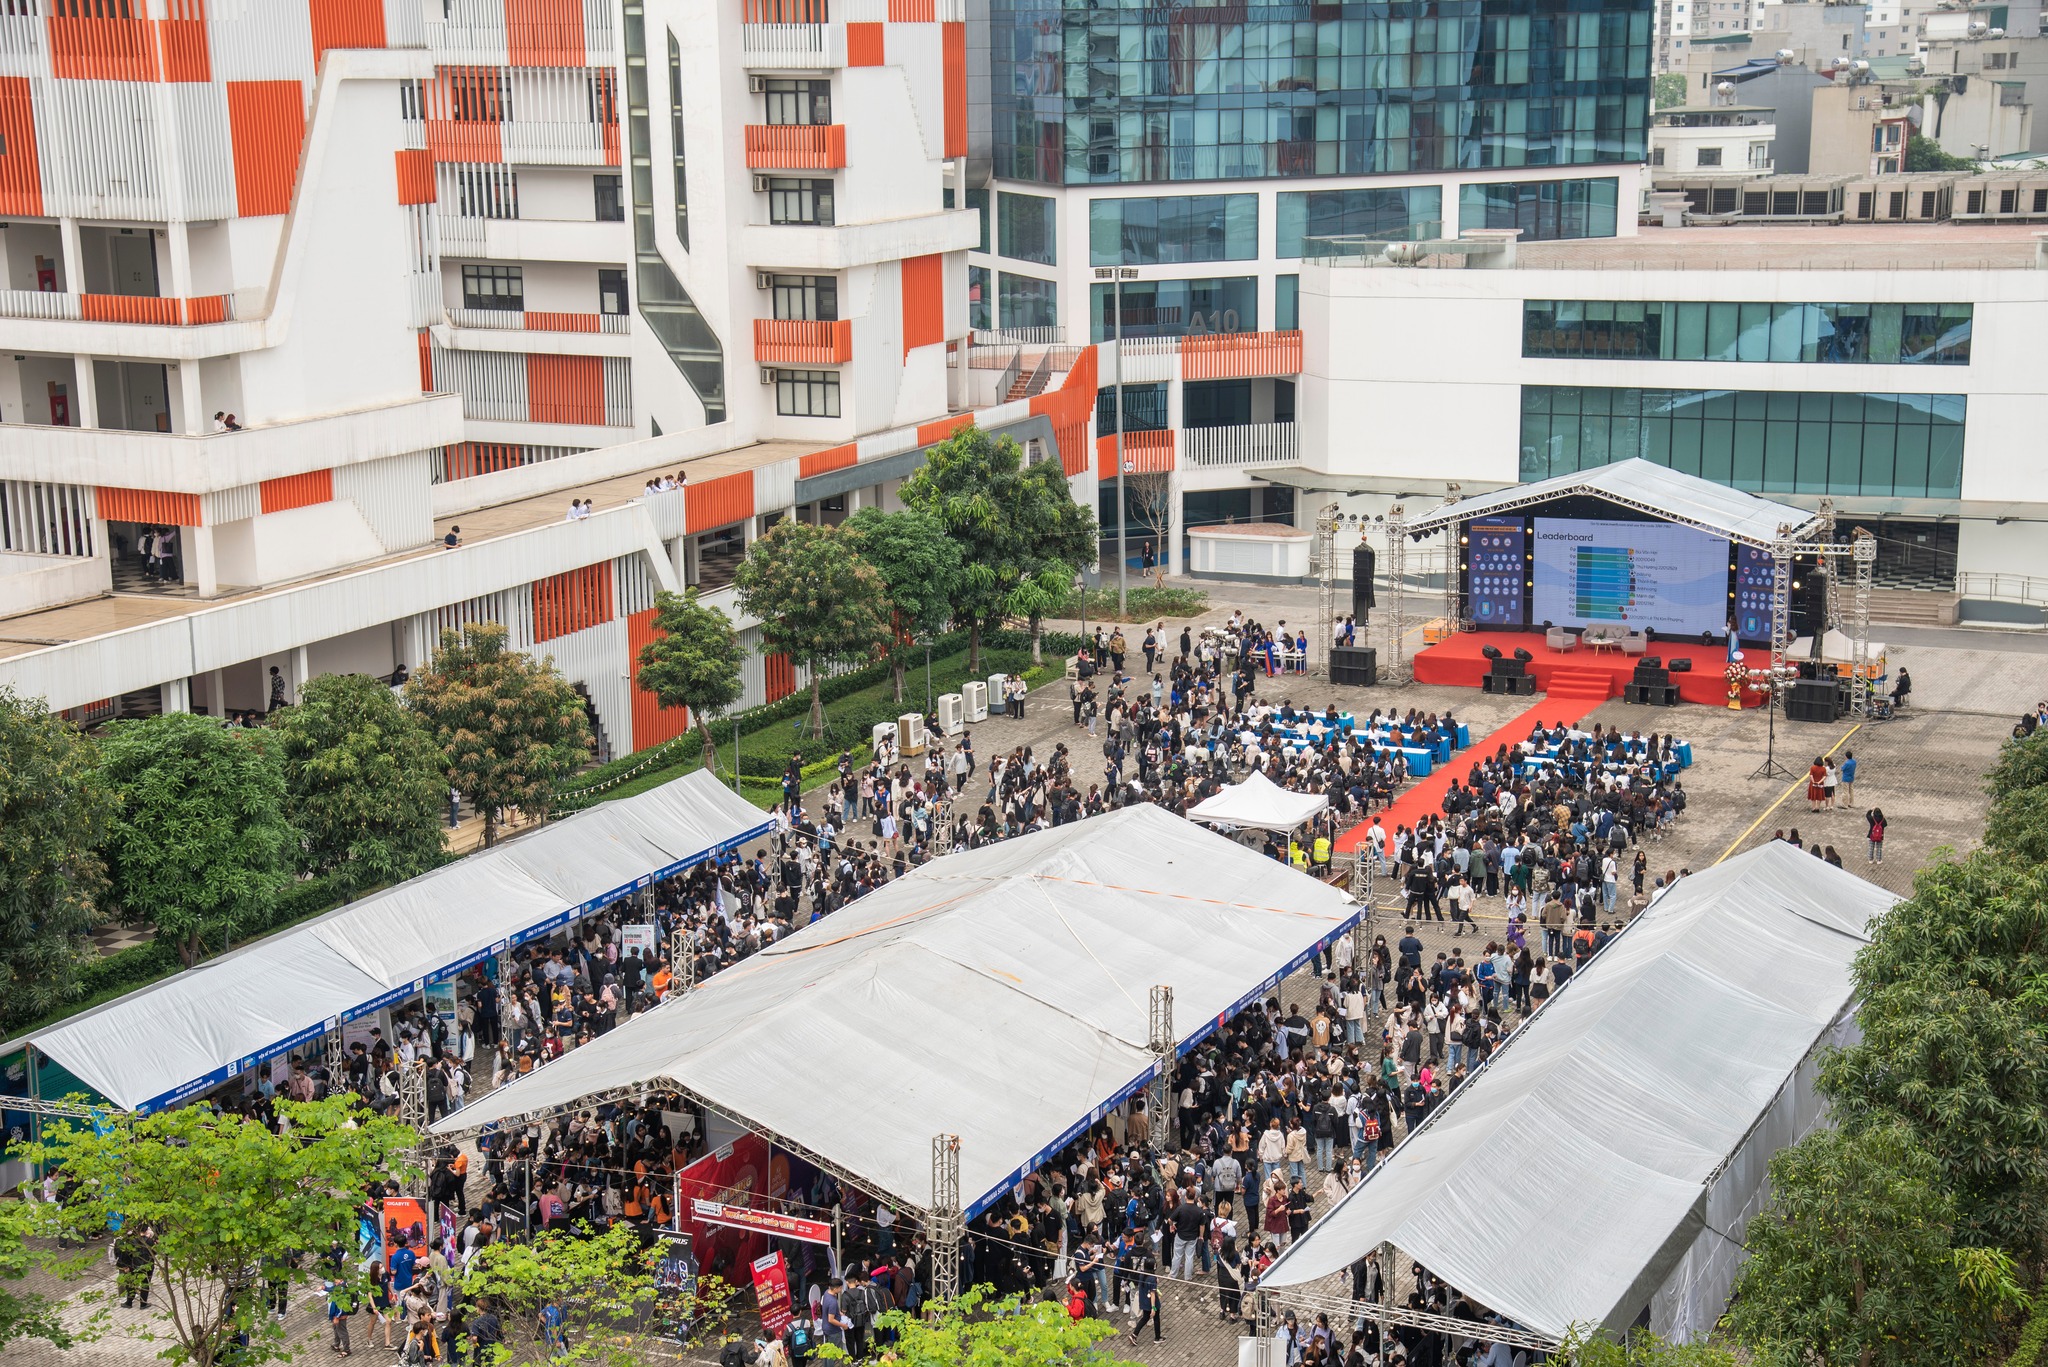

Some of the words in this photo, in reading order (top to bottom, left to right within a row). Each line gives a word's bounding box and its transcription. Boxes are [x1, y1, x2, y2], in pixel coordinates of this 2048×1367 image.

[1187, 309, 1239, 336] A10
[1537, 531, 1593, 541] Leaderboard
[997, 1180, 1009, 1195] SCHOOL
[760, 1297, 773, 1307] GIÁO
[772, 1290, 787, 1301] VIÊN
